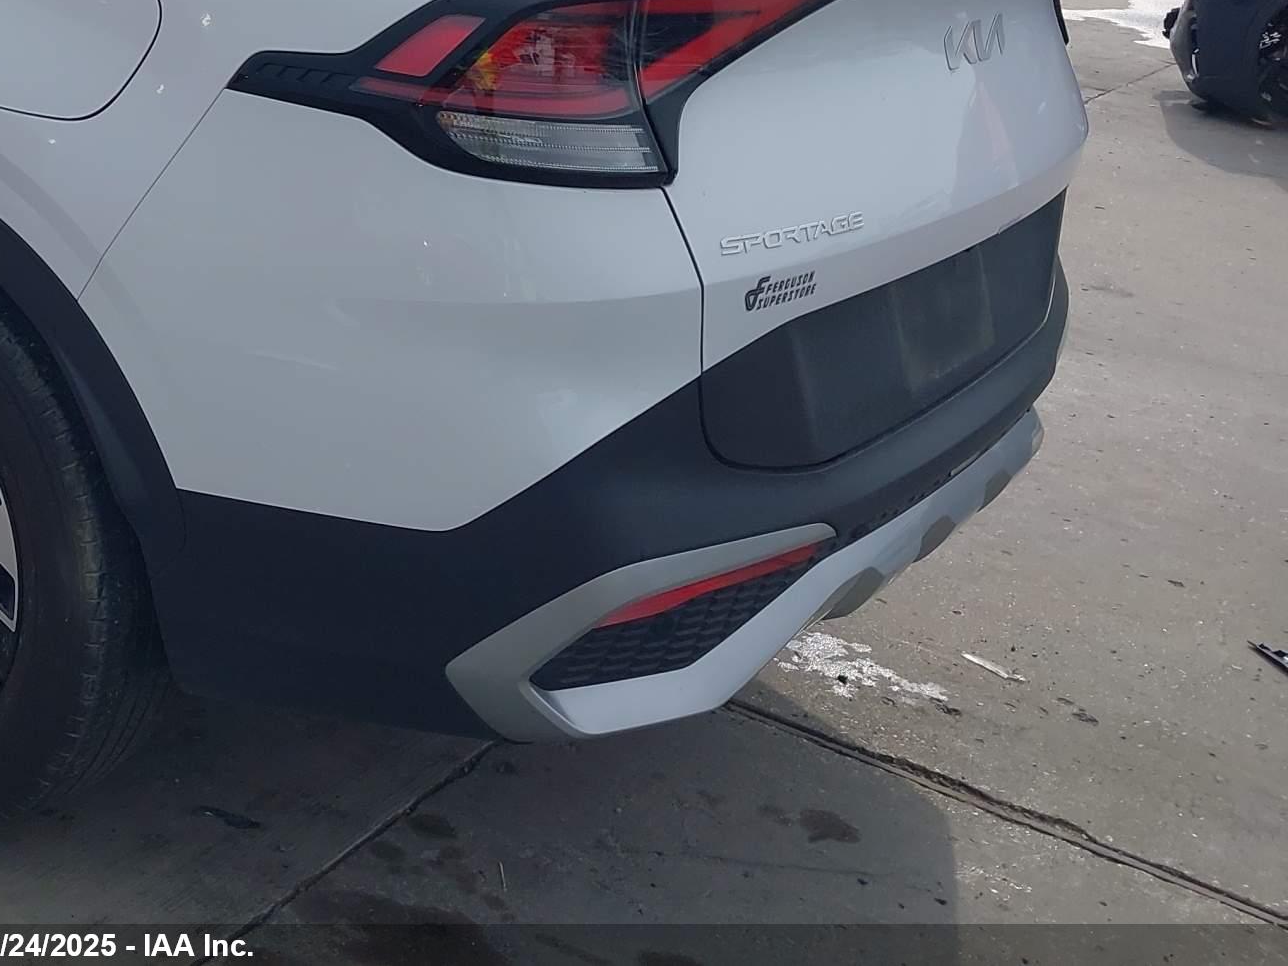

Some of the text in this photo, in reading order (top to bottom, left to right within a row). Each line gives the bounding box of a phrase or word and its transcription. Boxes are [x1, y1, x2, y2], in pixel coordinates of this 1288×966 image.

[943, 13, 1005, 71] KIA
[720, 211, 865, 256] SPORTAGE
[757, 283, 817, 310] SUPERSTORE
[765, 270, 815, 295] FERGUSON
